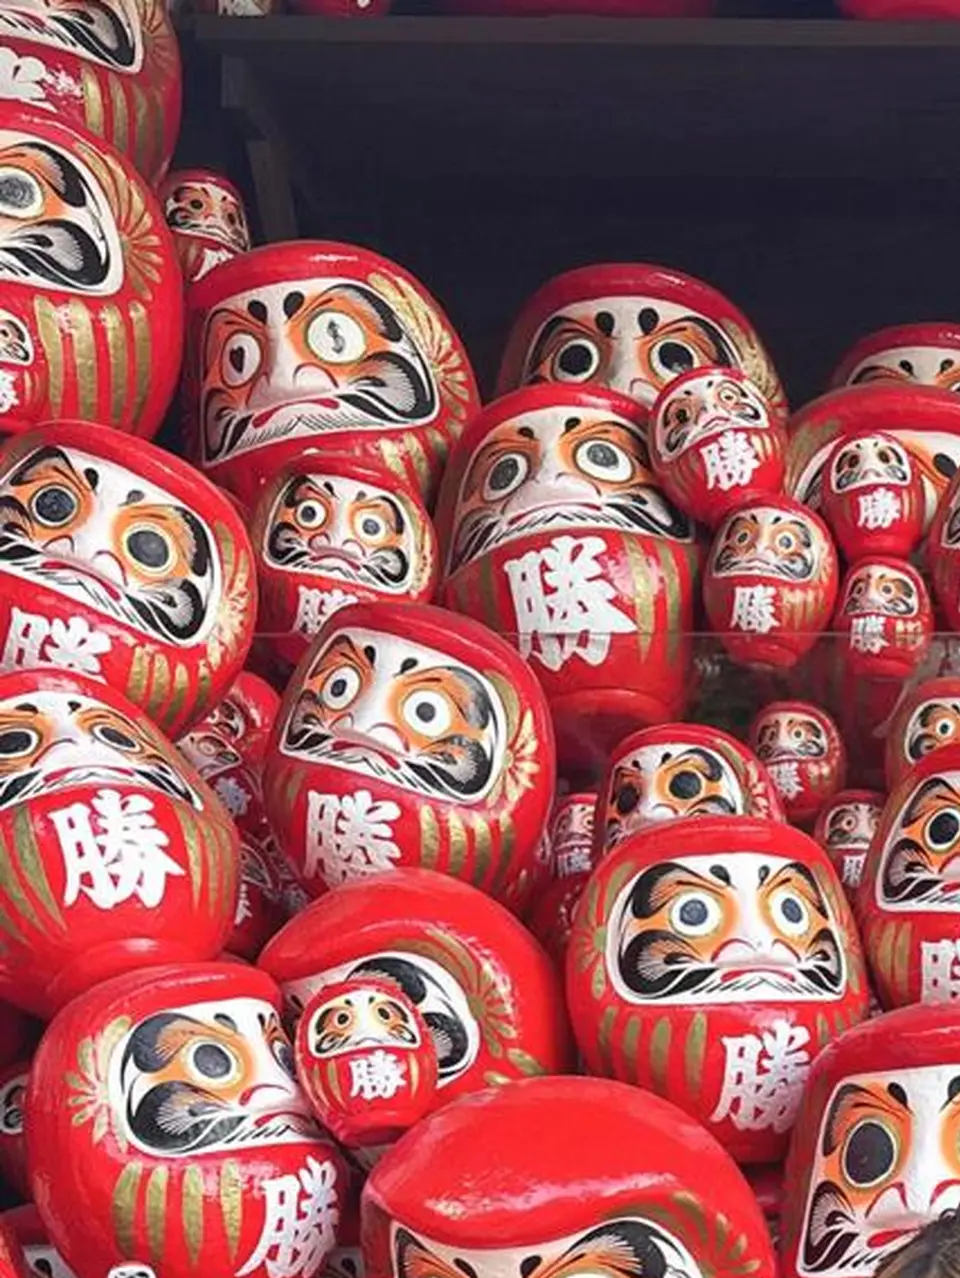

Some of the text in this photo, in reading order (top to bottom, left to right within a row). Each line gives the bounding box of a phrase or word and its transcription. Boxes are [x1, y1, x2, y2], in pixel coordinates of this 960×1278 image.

[700, 430, 760, 491] 勝
[857, 489, 900, 528] 勝
[503, 536, 637, 671] 勝
[731, 585, 778, 634] 勝
[850, 616, 890, 654] 勝
[49, 789, 185, 908] 勝
[304, 790, 400, 886] 勝
[349, 1049, 405, 1100] 勝
[711, 1020, 811, 1131] 勝
